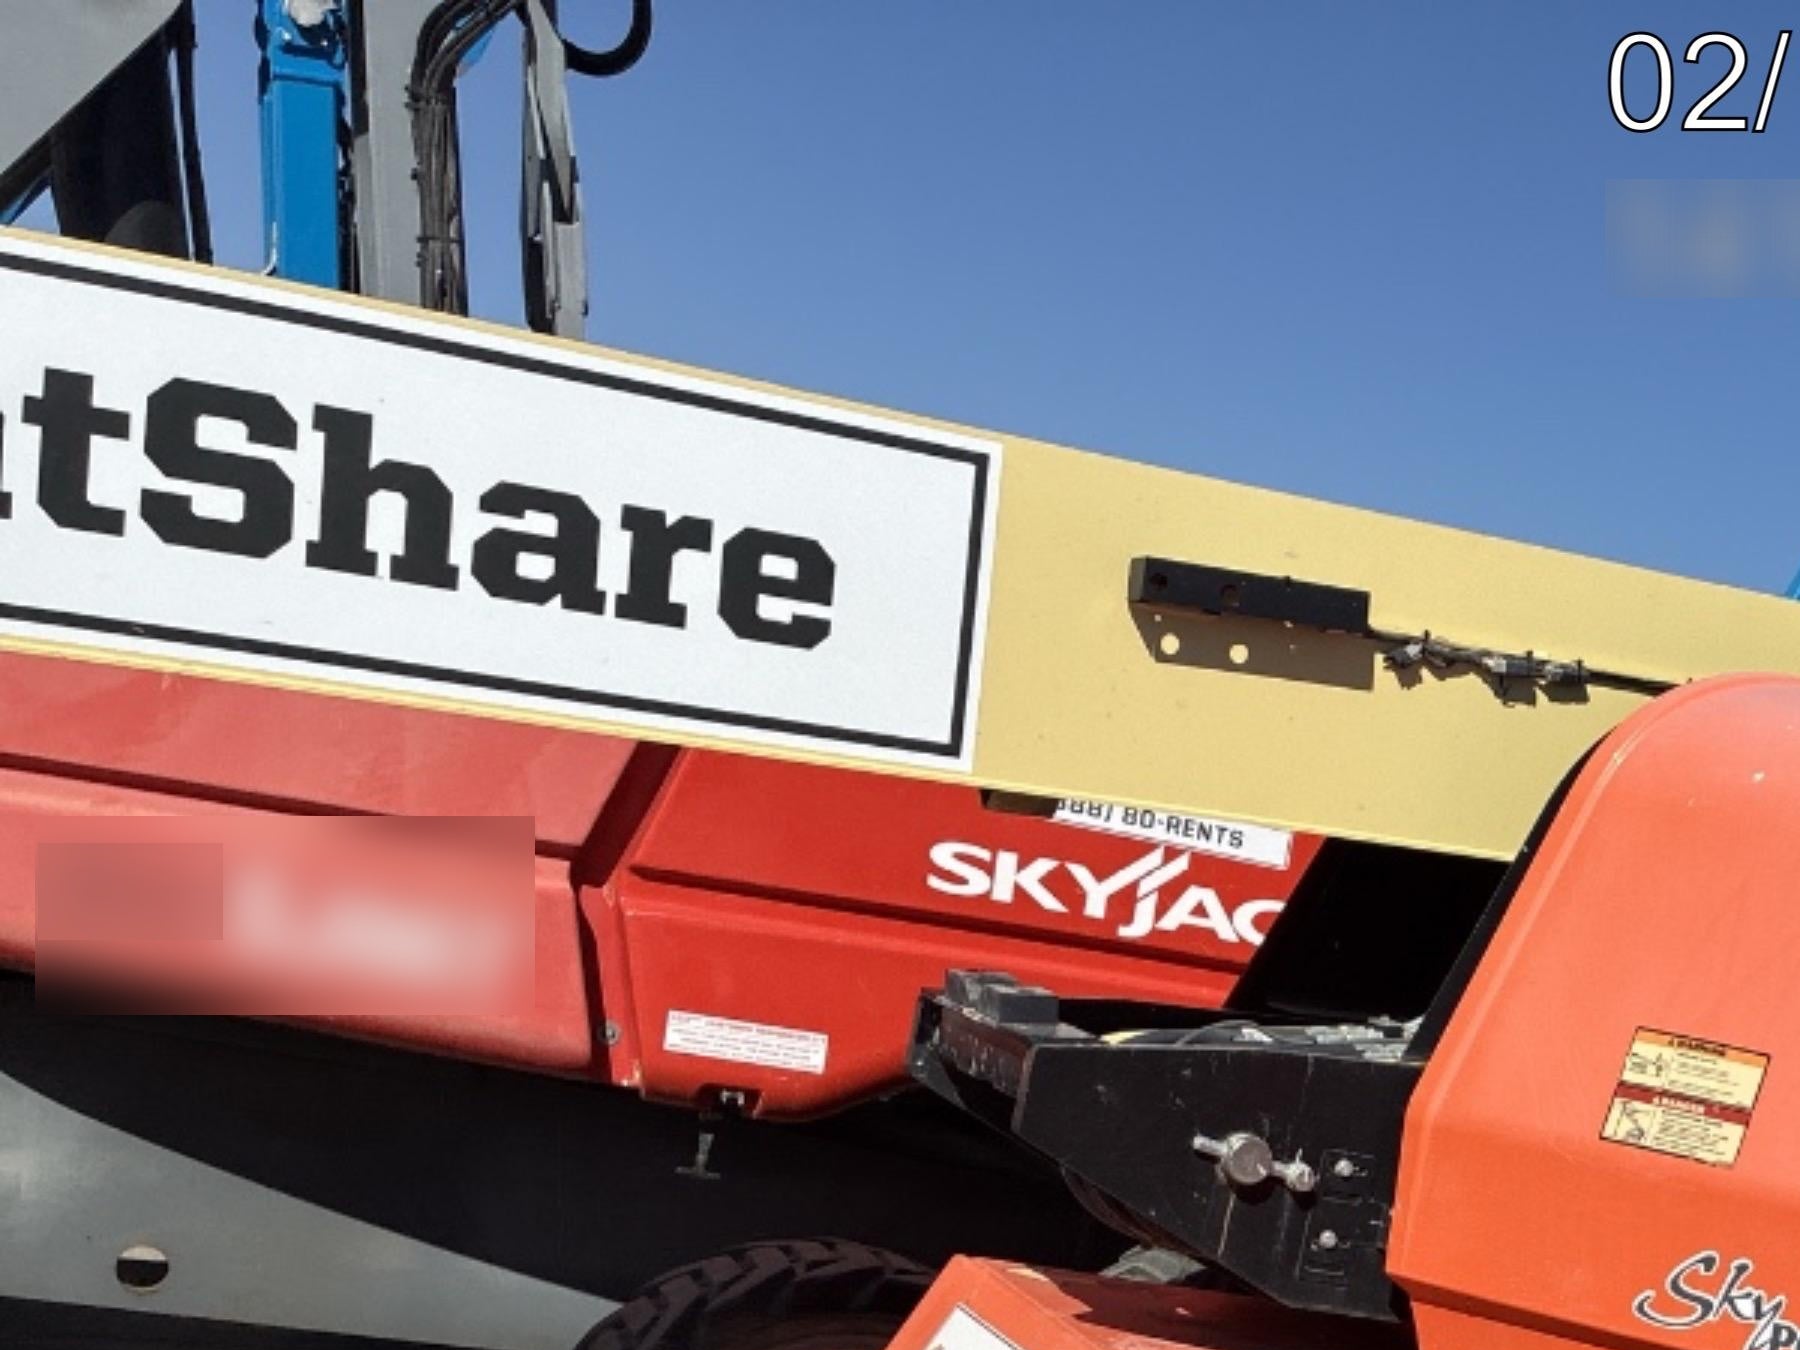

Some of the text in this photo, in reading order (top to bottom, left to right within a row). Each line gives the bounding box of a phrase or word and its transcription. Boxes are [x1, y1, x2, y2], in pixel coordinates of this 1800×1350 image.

[0, 366, 837, 650] tShare
[1121, 806, 1245, 849] 80-RENTS
[926, 841, 1288, 945] SKYJAC
